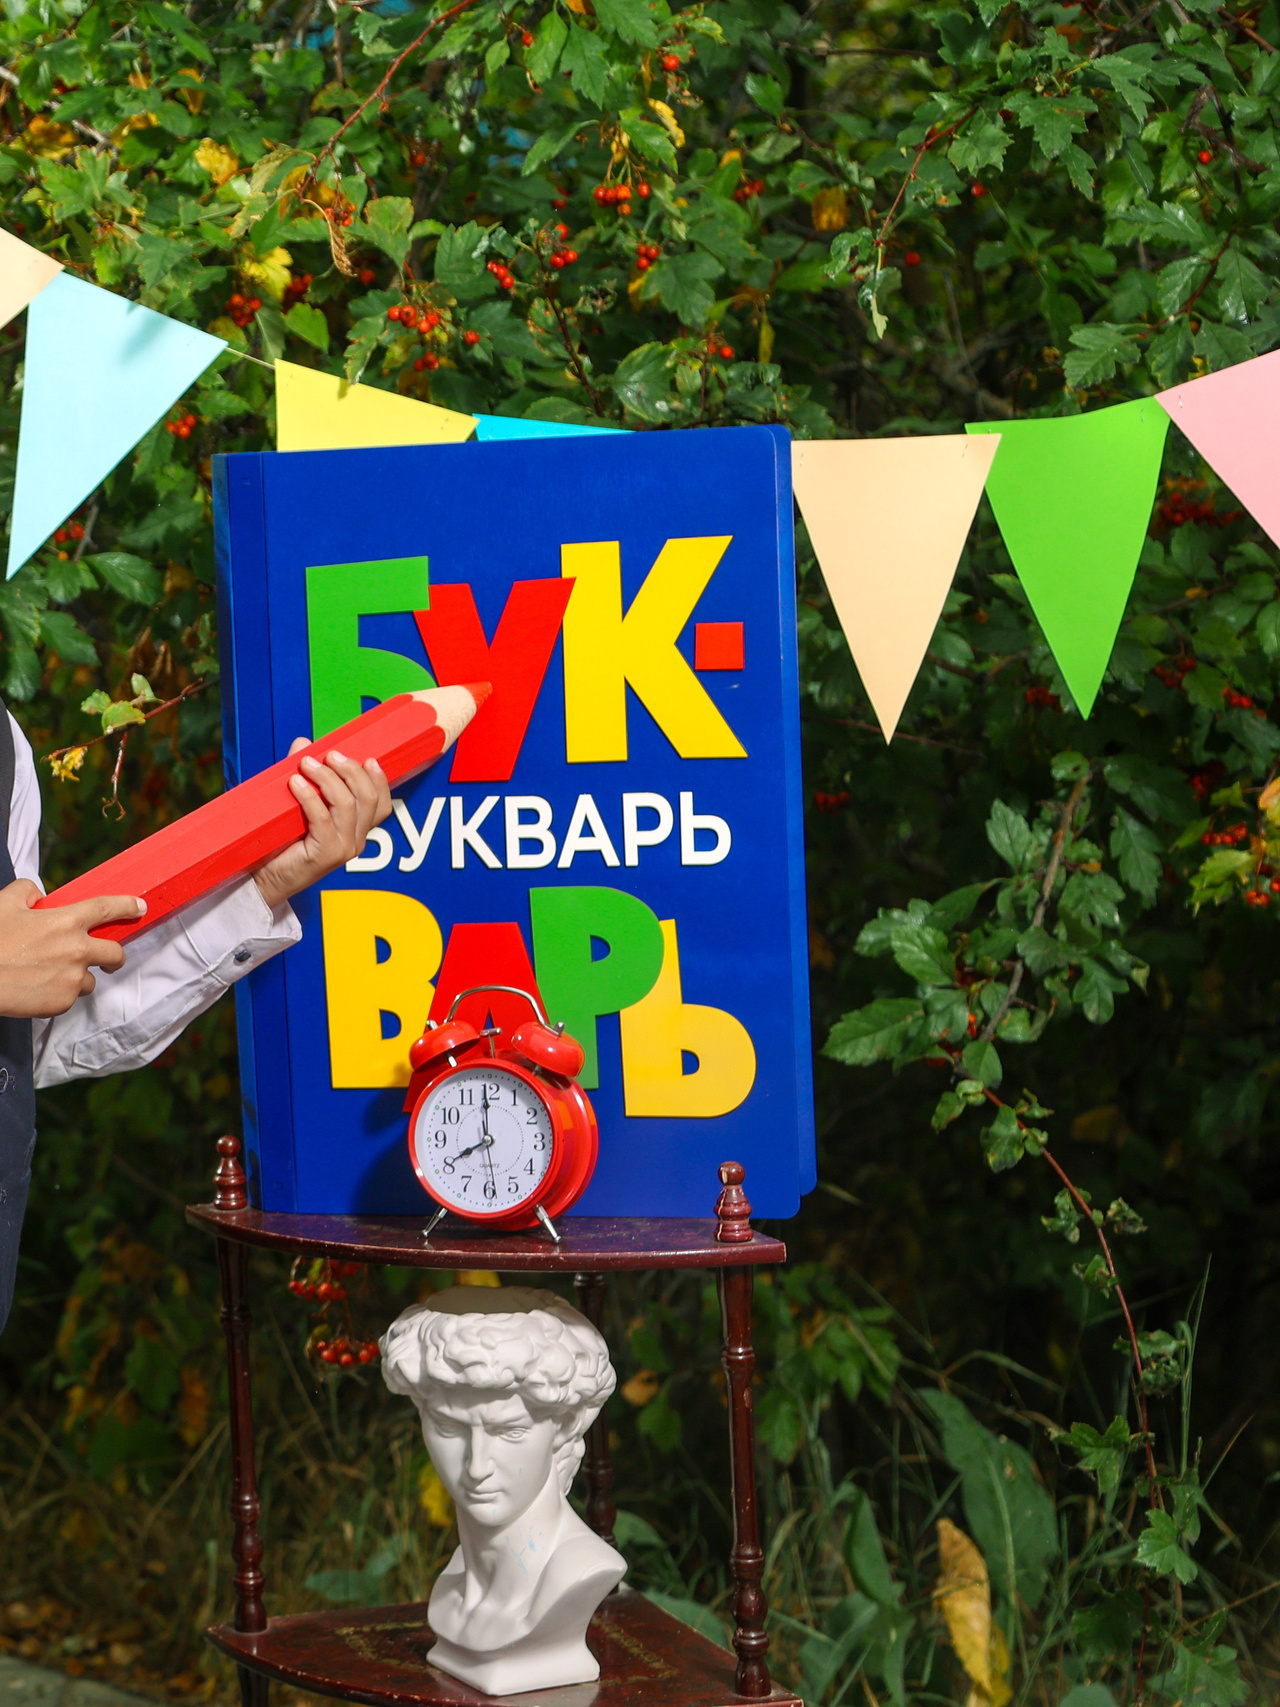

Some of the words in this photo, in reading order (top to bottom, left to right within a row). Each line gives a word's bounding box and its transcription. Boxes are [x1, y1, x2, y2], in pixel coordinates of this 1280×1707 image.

[320, 885, 757, 1118] ВАРЬ
[459, 1088, 475, 1106] 11
[481, 1083, 500, 1101] 12
[511, 1088, 519, 1106] 1
[441, 1107, 460, 1125] 10
[526, 1107, 538, 1125] 2
[434, 1130, 447, 1149] 9
[533, 1132, 546, 1151] 3
[442, 1156, 456, 1175] 8
[523, 1157, 536, 1175] 4
[461, 1175, 472, 1193] 7
[483, 1180, 496, 1200] 6
[507, 1176, 519, 1194] 5
